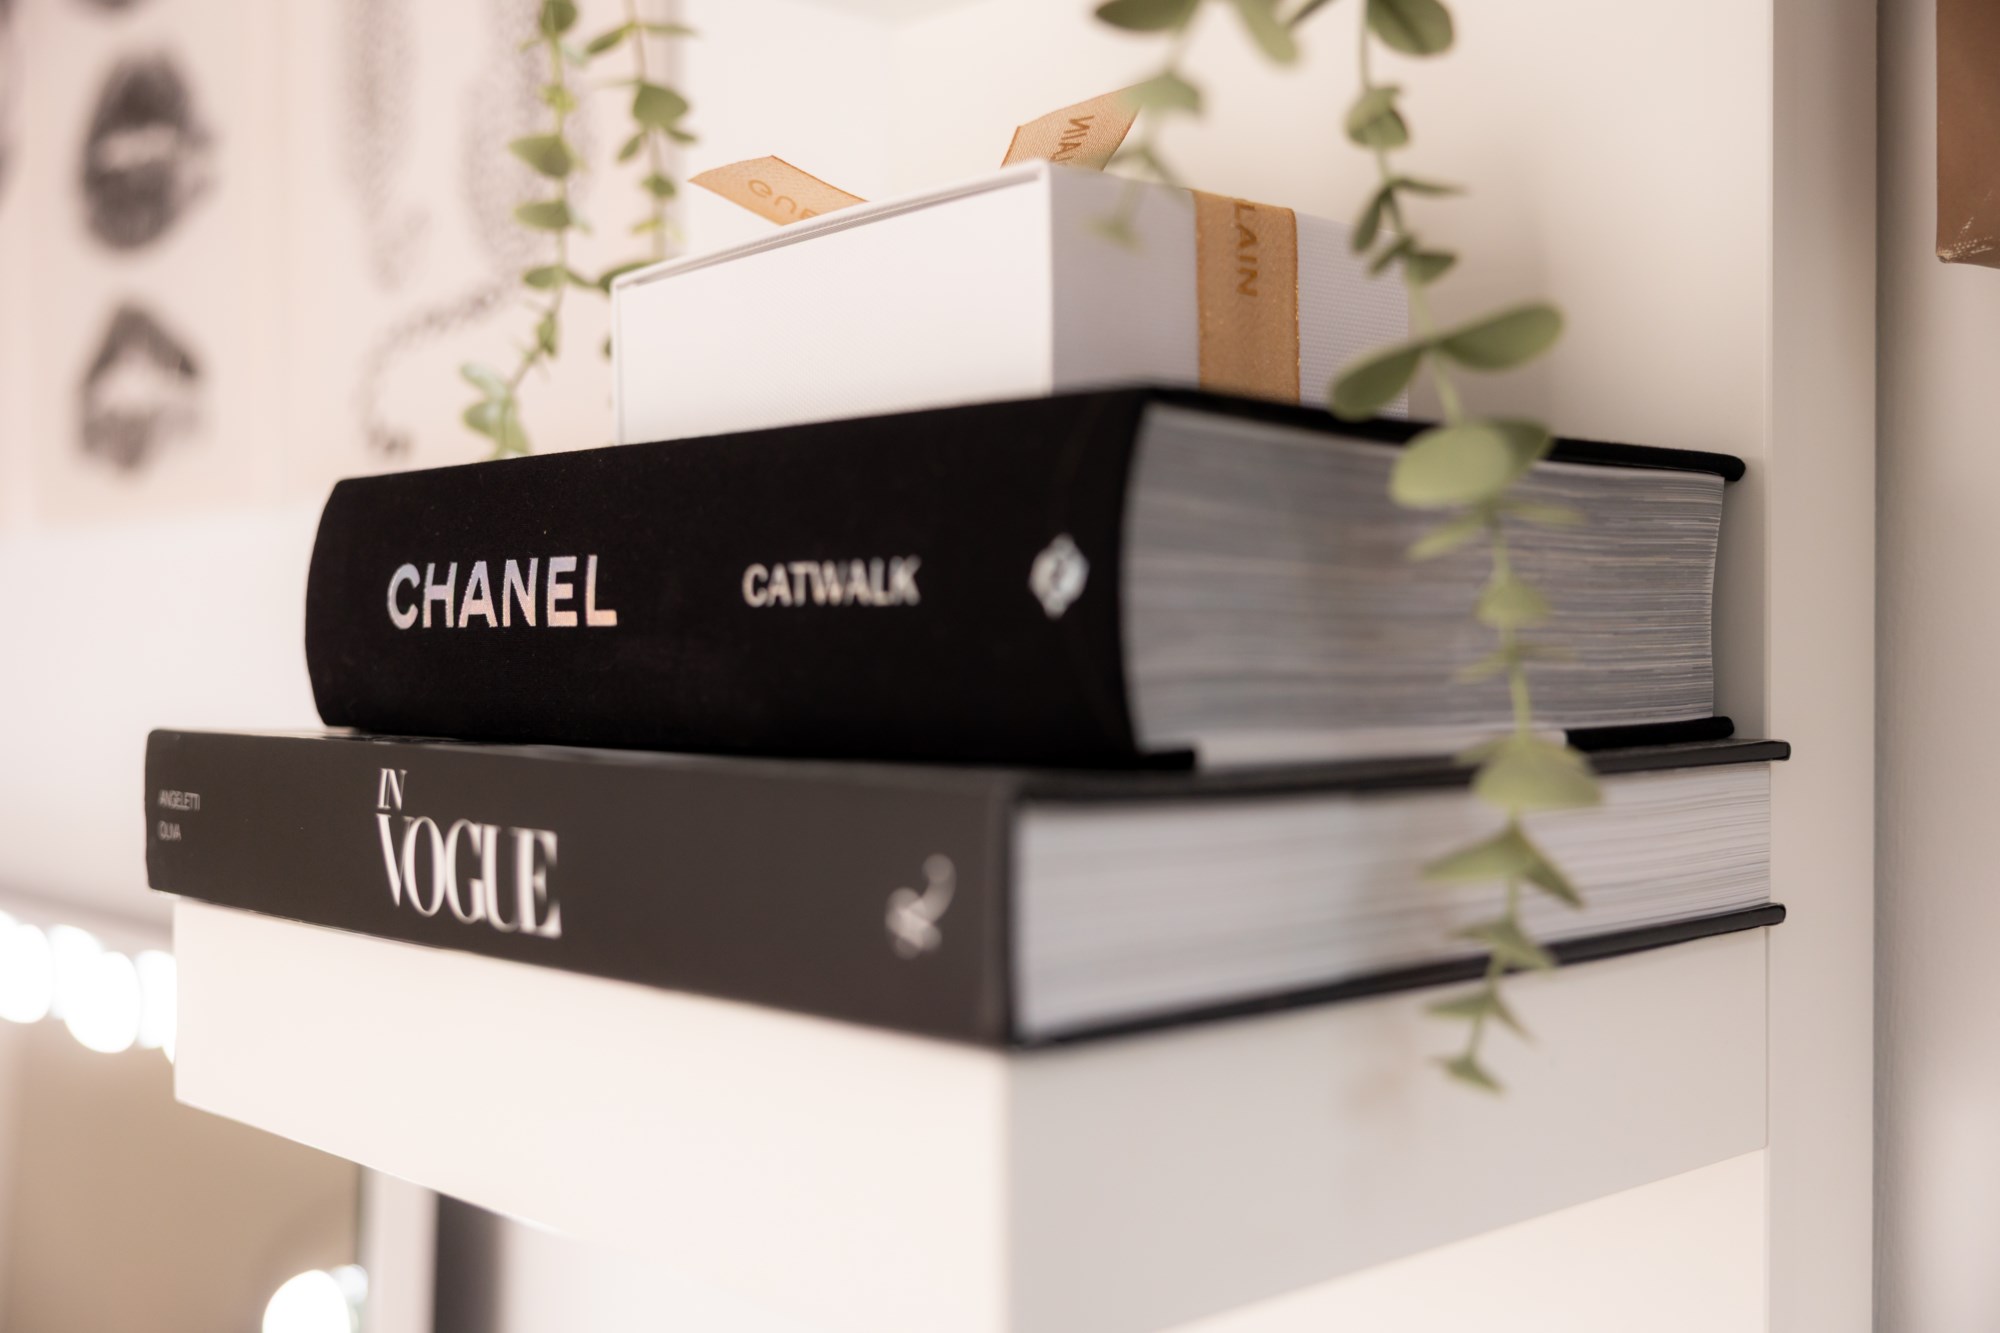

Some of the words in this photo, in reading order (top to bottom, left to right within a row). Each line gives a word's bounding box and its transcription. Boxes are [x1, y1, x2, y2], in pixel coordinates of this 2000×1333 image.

[386, 554, 618, 630] CHANEL
[741, 554, 922, 608] CATWALK
[377, 767, 408, 811] IN
[375, 812, 562, 939] VOGUE
